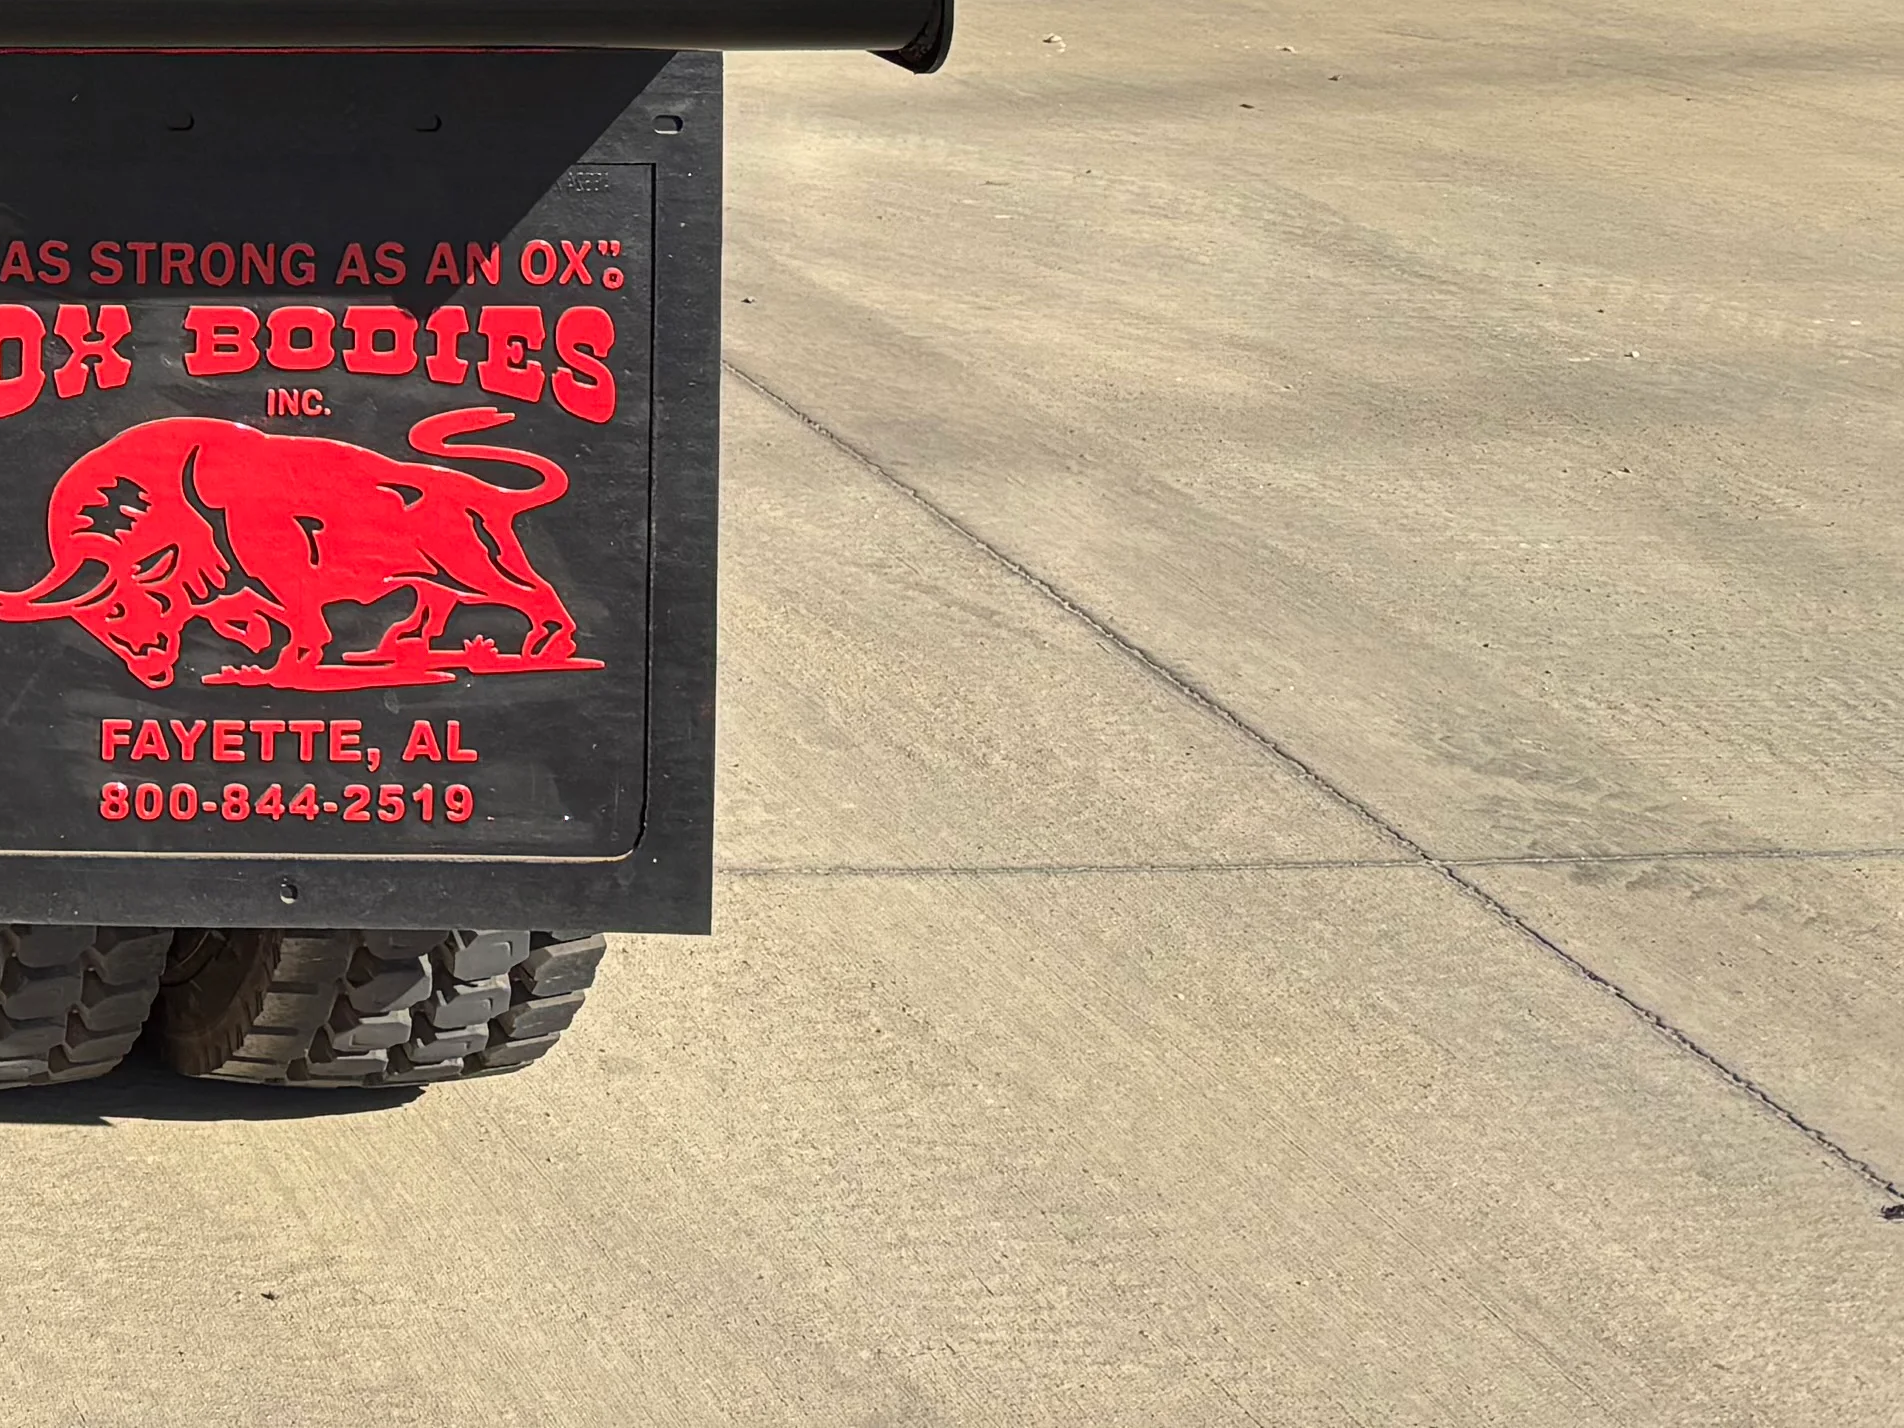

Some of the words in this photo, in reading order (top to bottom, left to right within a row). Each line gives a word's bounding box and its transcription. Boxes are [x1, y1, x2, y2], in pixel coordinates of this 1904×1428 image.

[91, 242, 316, 287] STRONG
[336, 243, 406, 286] AS
[426, 243, 502, 287] AN
[183, 304, 618, 425] BODIES
[264, 387, 332, 418] INC.
[100, 718, 383, 774] FAYETTE,
[402, 720, 480, 764] AL
[99, 783, 475, 824] 800-844-2519
